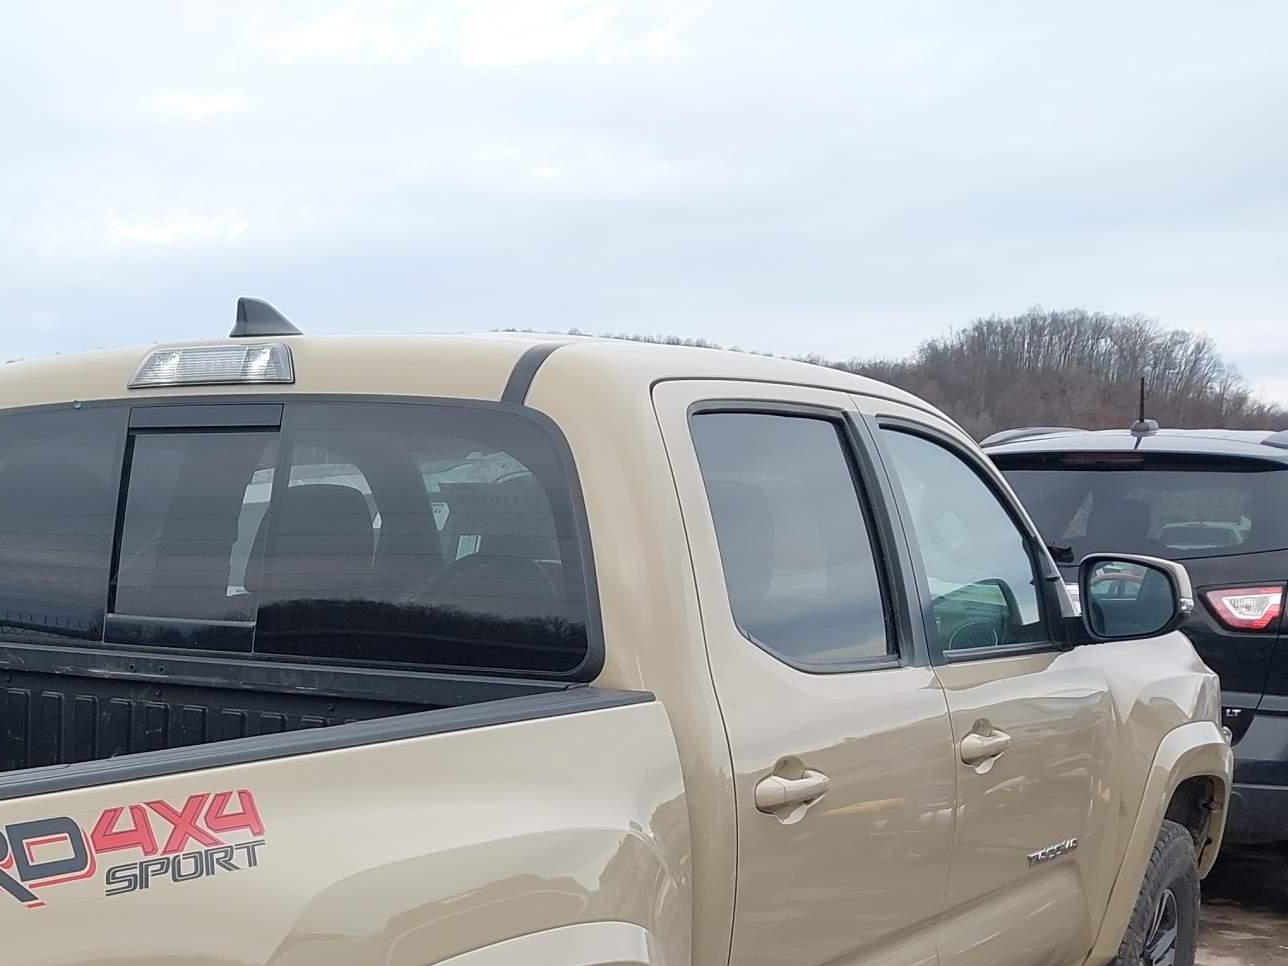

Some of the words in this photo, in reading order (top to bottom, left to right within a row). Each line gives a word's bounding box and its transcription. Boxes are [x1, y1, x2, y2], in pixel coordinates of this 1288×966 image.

[1225, 708, 1242, 717] LT
[90, 789, 265, 856] 4X4
[105, 838, 266, 897] SPORT
